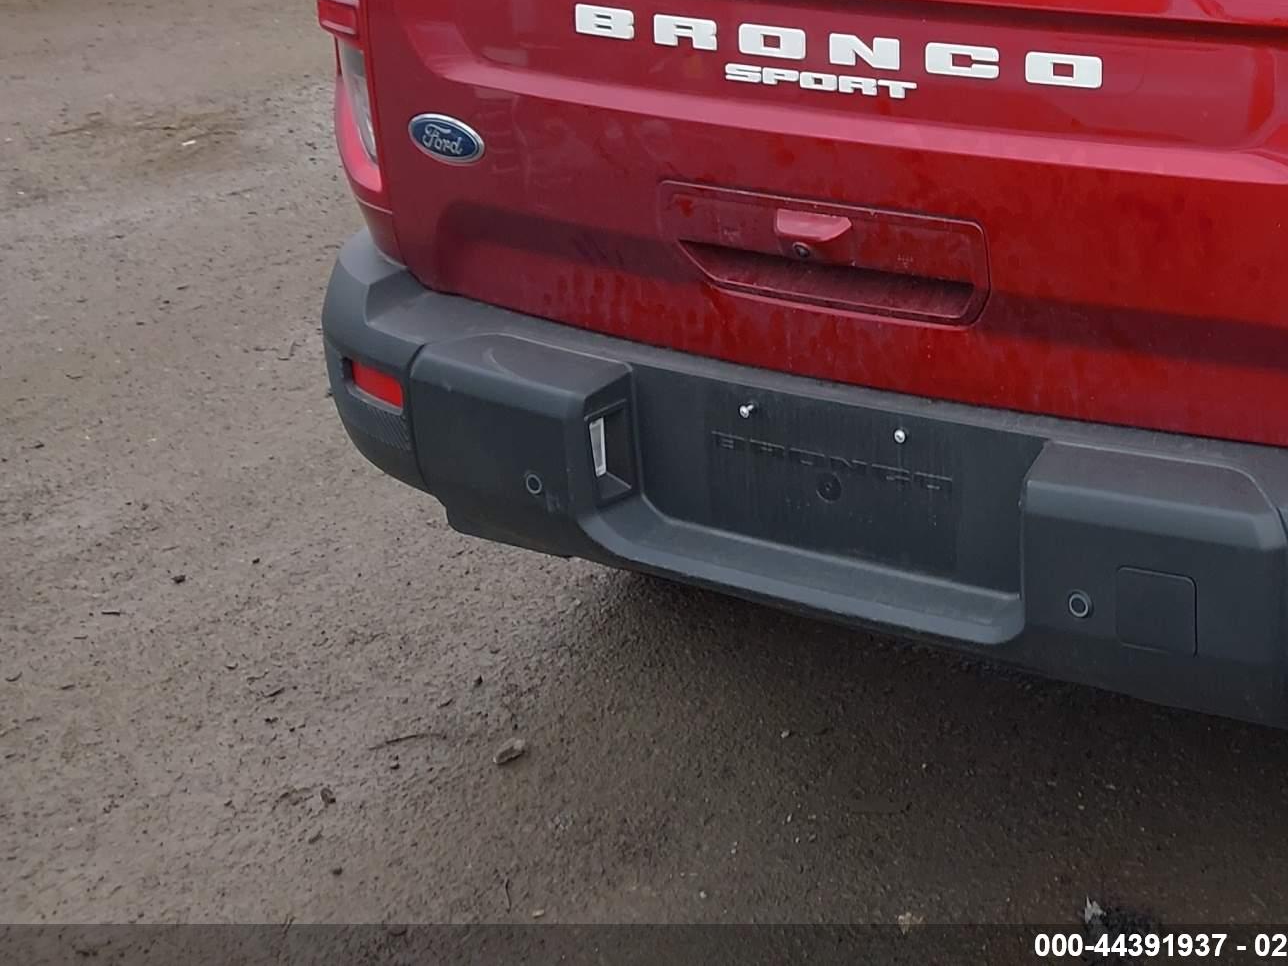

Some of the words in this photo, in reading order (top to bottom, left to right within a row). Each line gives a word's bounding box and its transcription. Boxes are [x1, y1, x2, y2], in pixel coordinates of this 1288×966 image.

[575, 3, 1103, 89] BRONCO
[724, 63, 918, 99] SPORT
[422, 123, 464, 155] Ford
